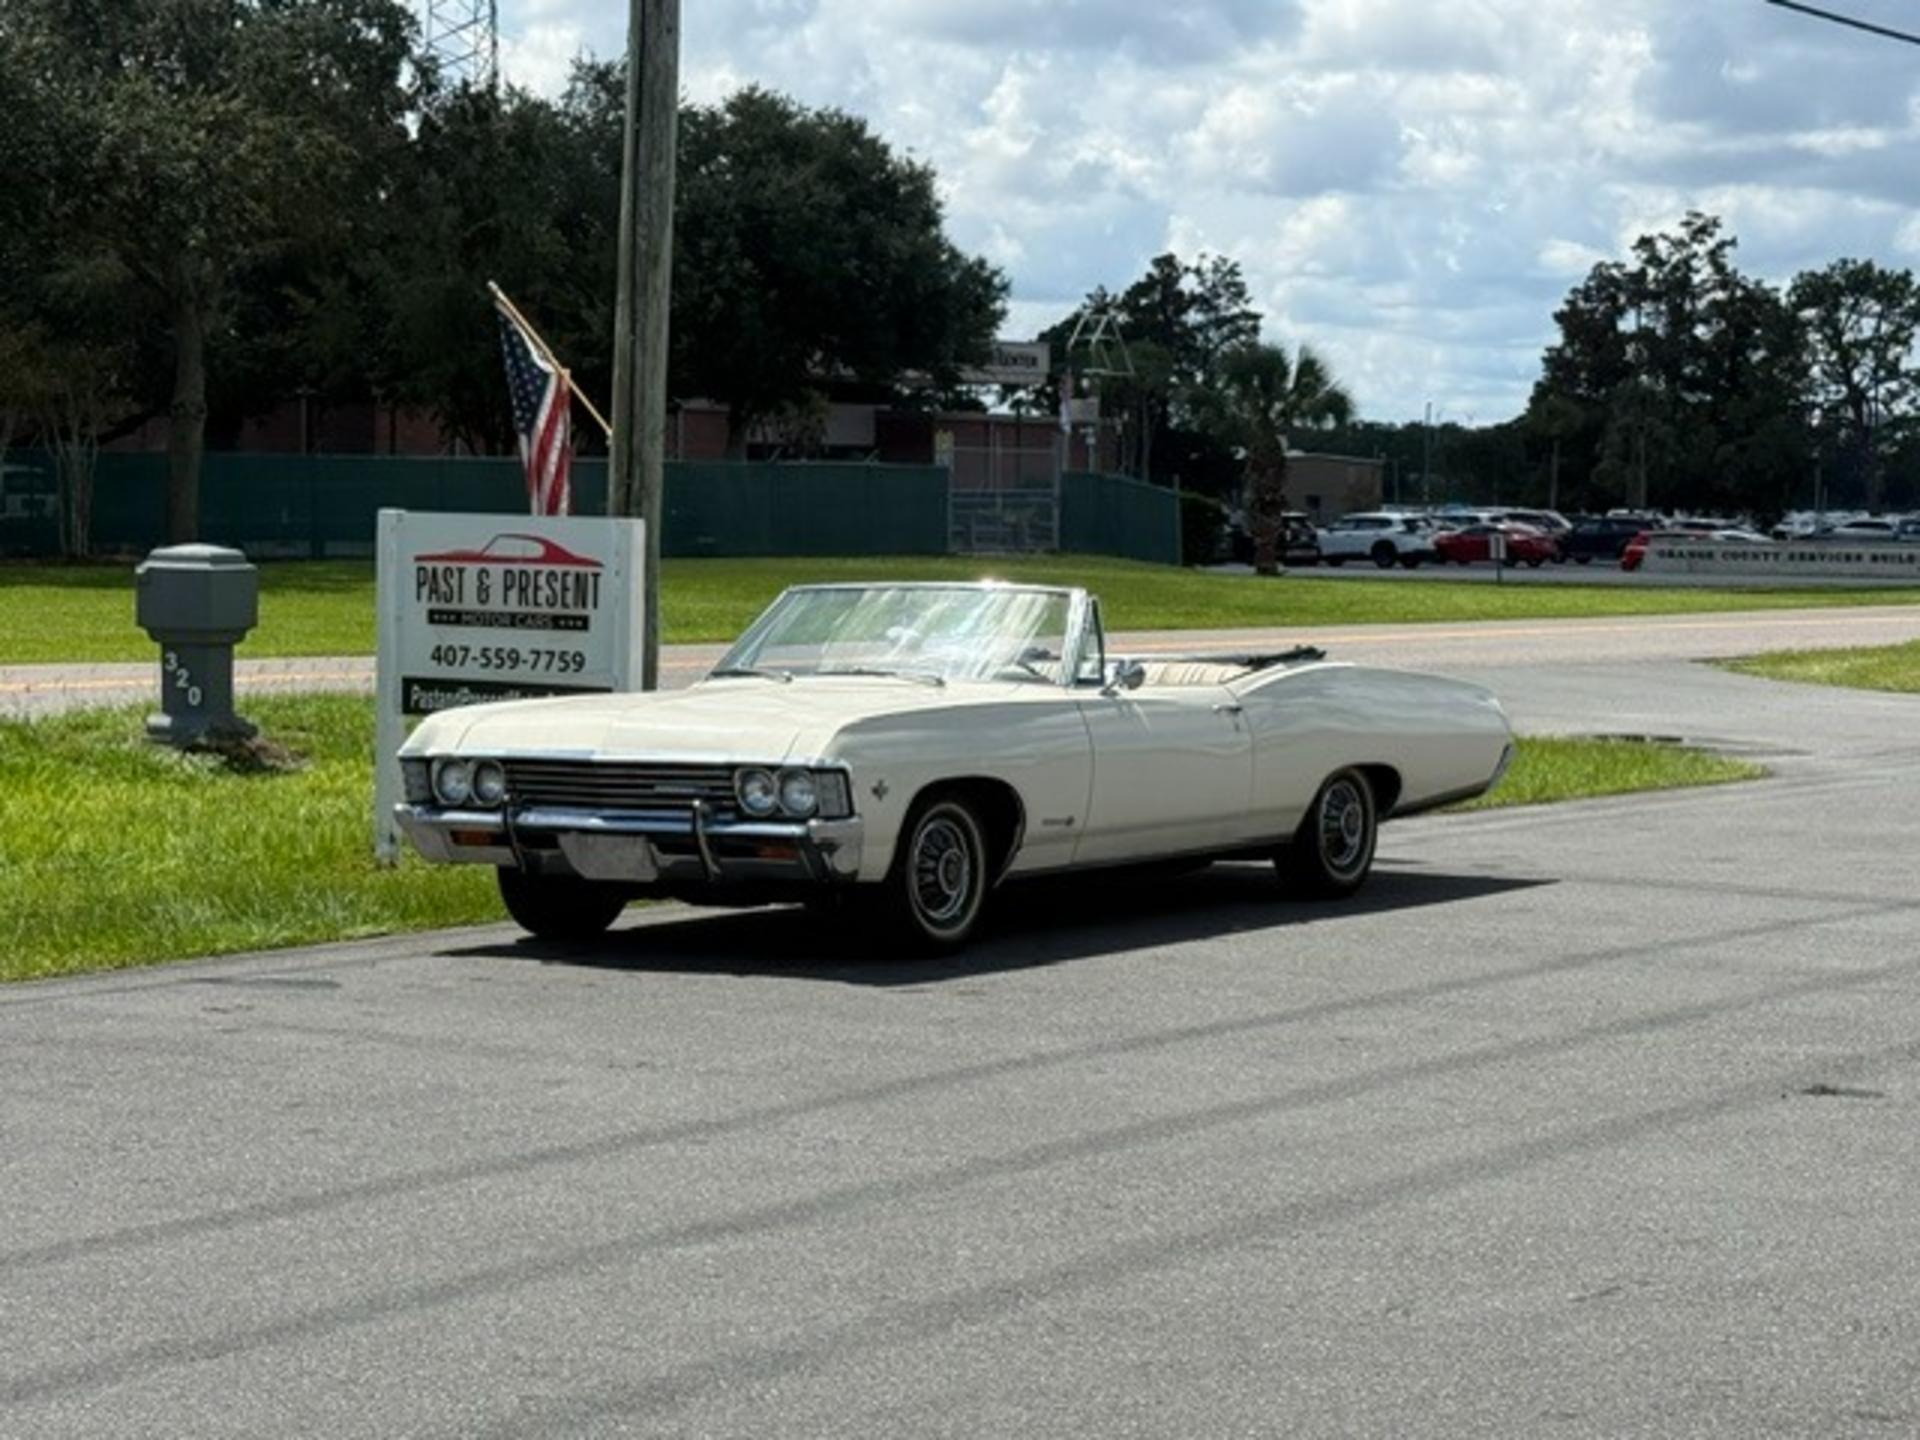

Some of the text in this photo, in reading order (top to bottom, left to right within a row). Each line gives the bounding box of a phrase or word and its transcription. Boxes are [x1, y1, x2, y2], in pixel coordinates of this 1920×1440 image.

[416, 566, 602, 610] PAST & PRESENT
[461, 612, 554, 630] MOTOR CARS
[431, 645, 586, 673] 407-559-7759
